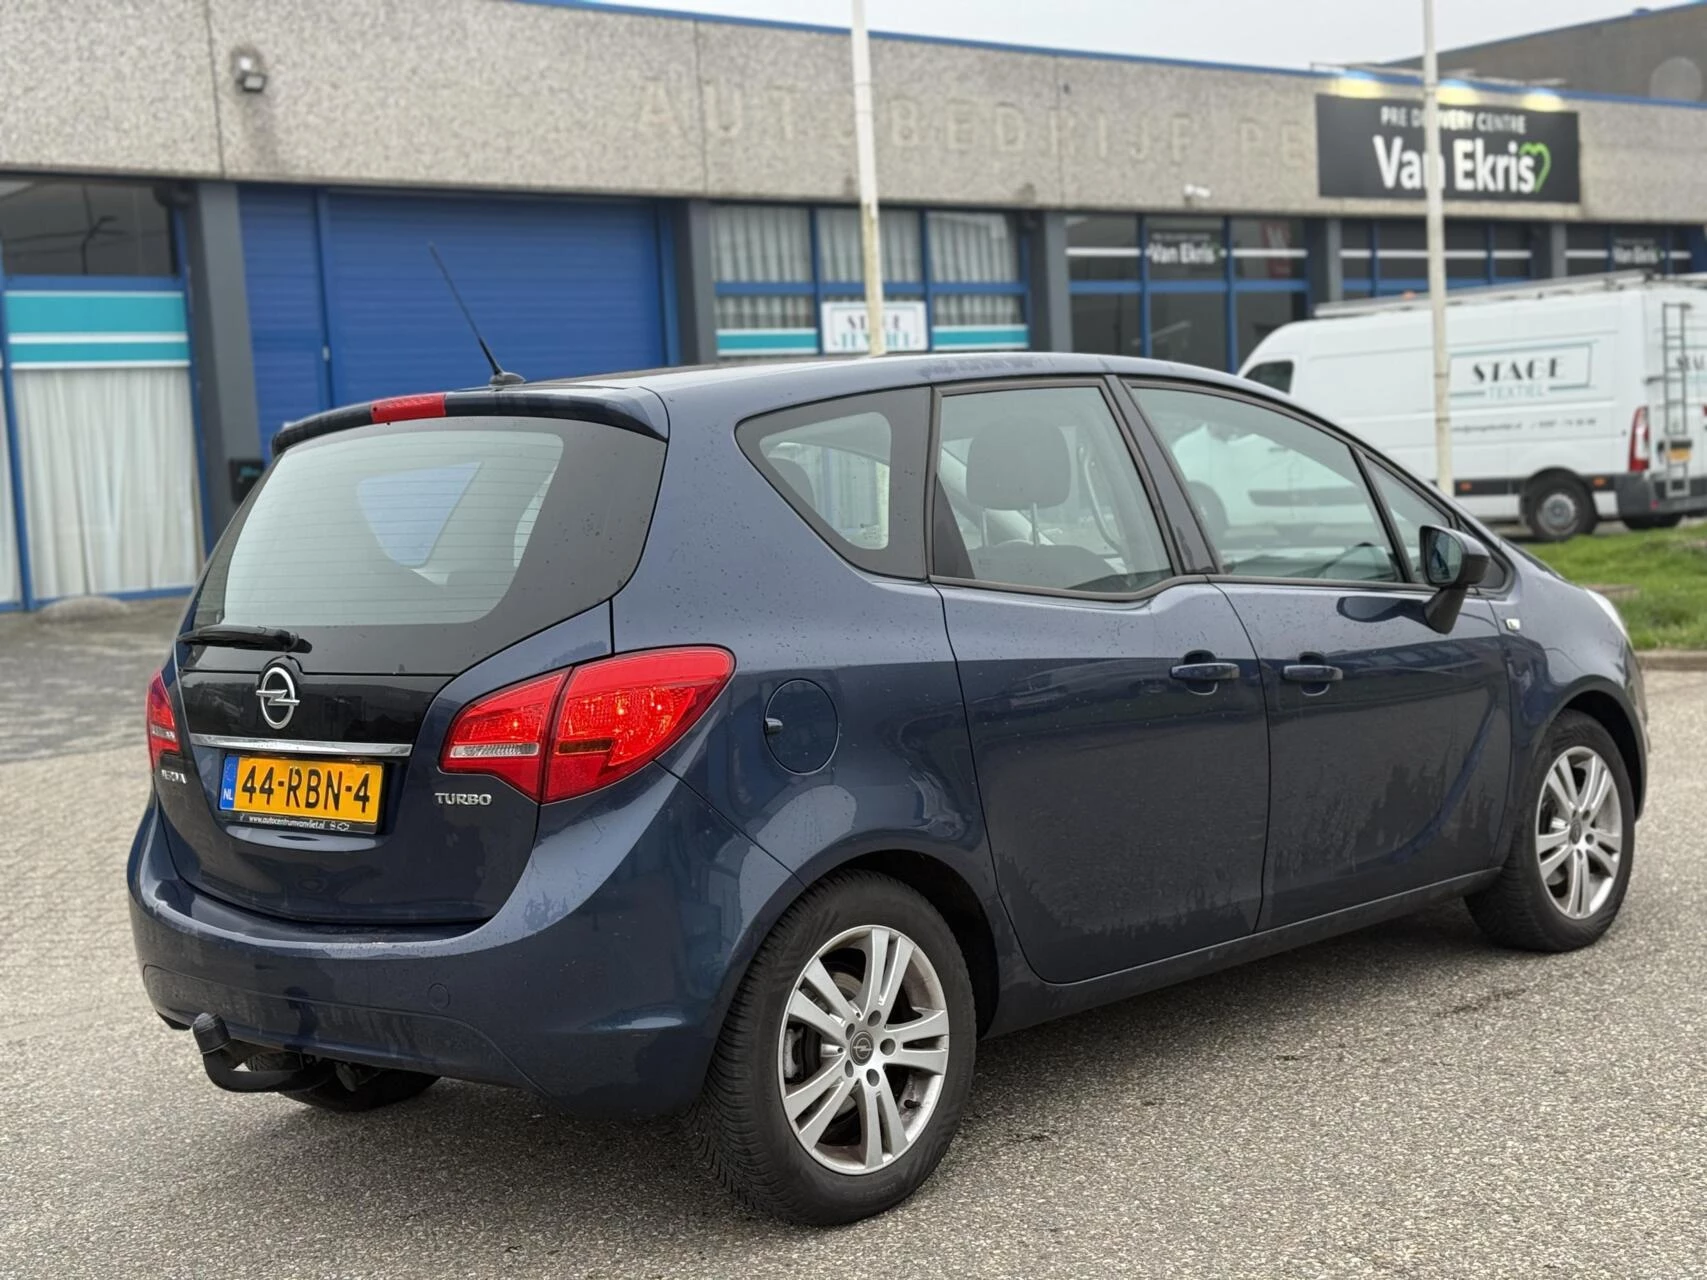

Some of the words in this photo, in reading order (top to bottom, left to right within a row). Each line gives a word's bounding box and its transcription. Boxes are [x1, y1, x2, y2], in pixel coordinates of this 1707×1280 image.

[1381, 106, 1407, 127] PRE
[1476, 111, 1526, 135] CENTRE
[1453, 138, 1536, 193] Ekris
[1148, 241, 1178, 264] Van
[1470, 356, 1565, 385] STAGE
[223, 789, 234, 801] NL
[241, 765, 370, 813] 44-RBN-4
[434, 792, 492, 806] TURBO
